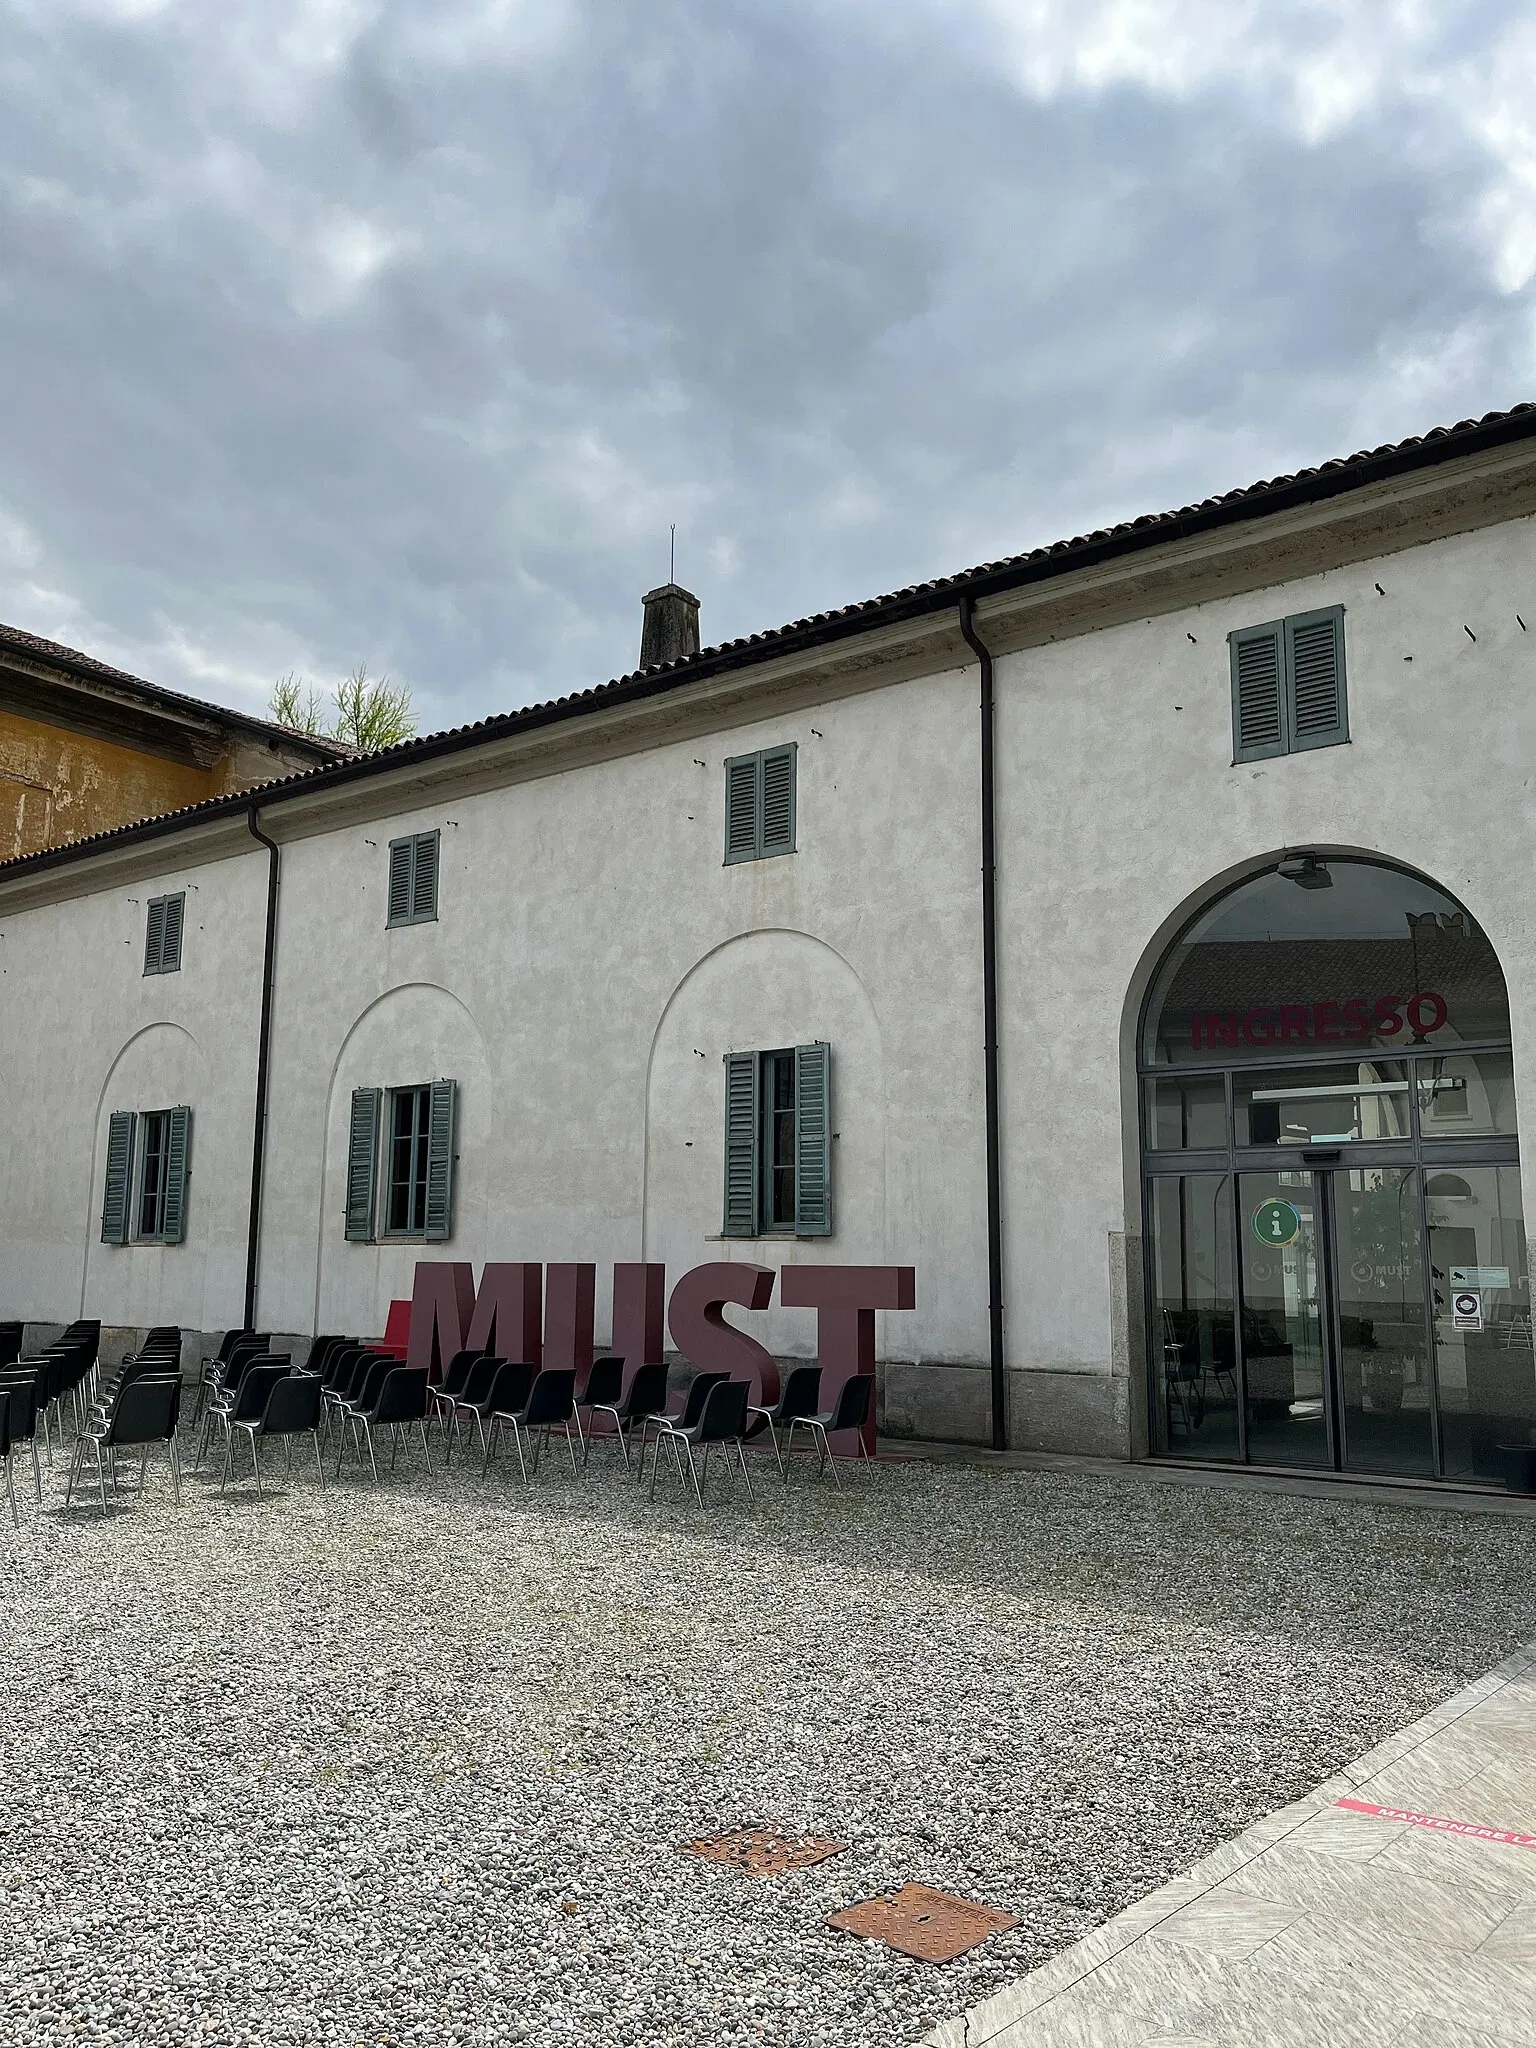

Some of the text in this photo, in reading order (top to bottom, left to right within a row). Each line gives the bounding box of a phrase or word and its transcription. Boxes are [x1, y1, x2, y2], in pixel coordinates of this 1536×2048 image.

[1191, 991, 1447, 1051] INGRESSO
[1375, 1265, 1411, 1276] MUST
[407, 1261, 915, 1457] MUST
[1377, 1808, 1508, 1840] MANTENERE
